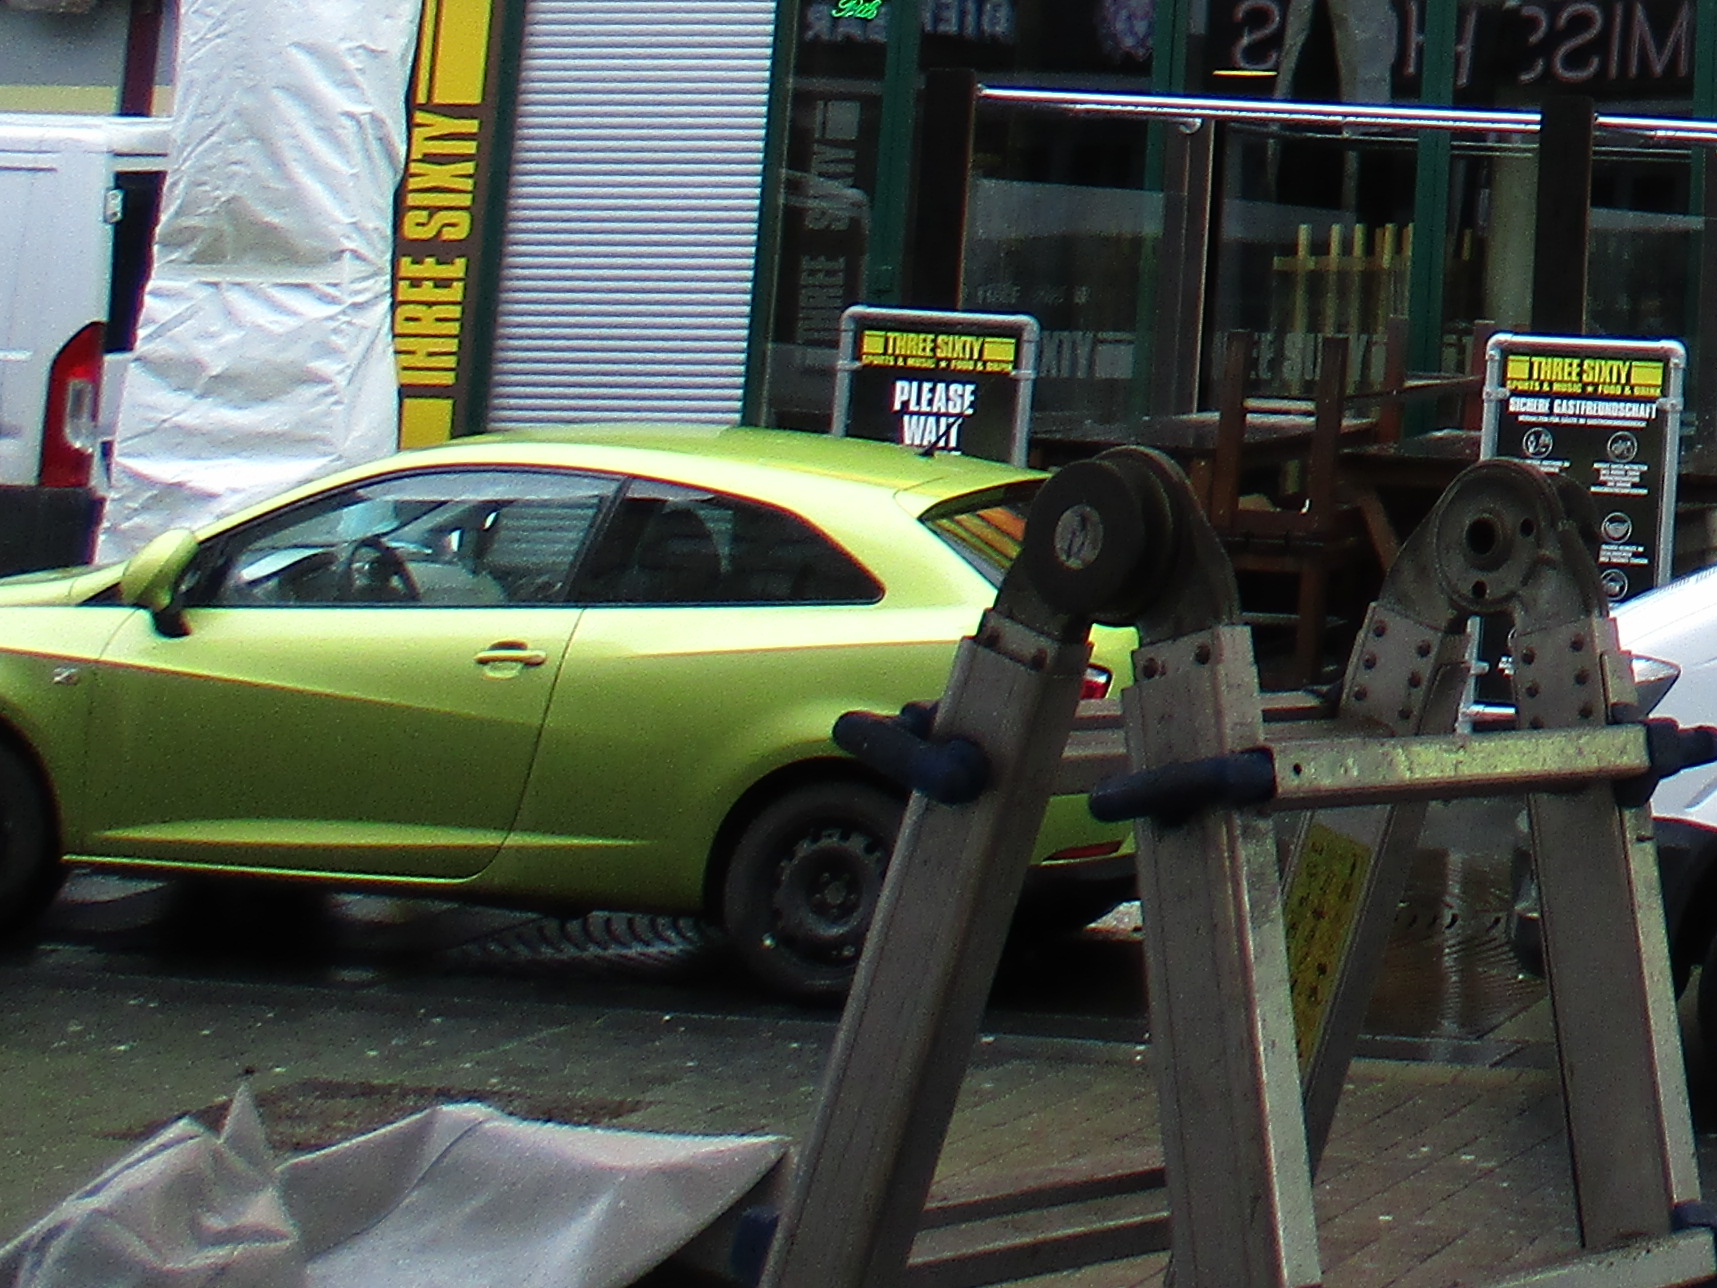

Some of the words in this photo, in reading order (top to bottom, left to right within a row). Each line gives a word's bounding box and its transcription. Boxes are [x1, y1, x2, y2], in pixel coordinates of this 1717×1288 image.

[403, 110, 480, 241] SIXTY
[886, 332, 935, 357] THREE
[936, 334, 984, 359] SIXTY
[1531, 357, 1581, 382] THREE
[1582, 359, 1630, 384] SIXTY
[893, 380, 976, 415] PLEASE
[902, 414, 964, 448] WAIT
